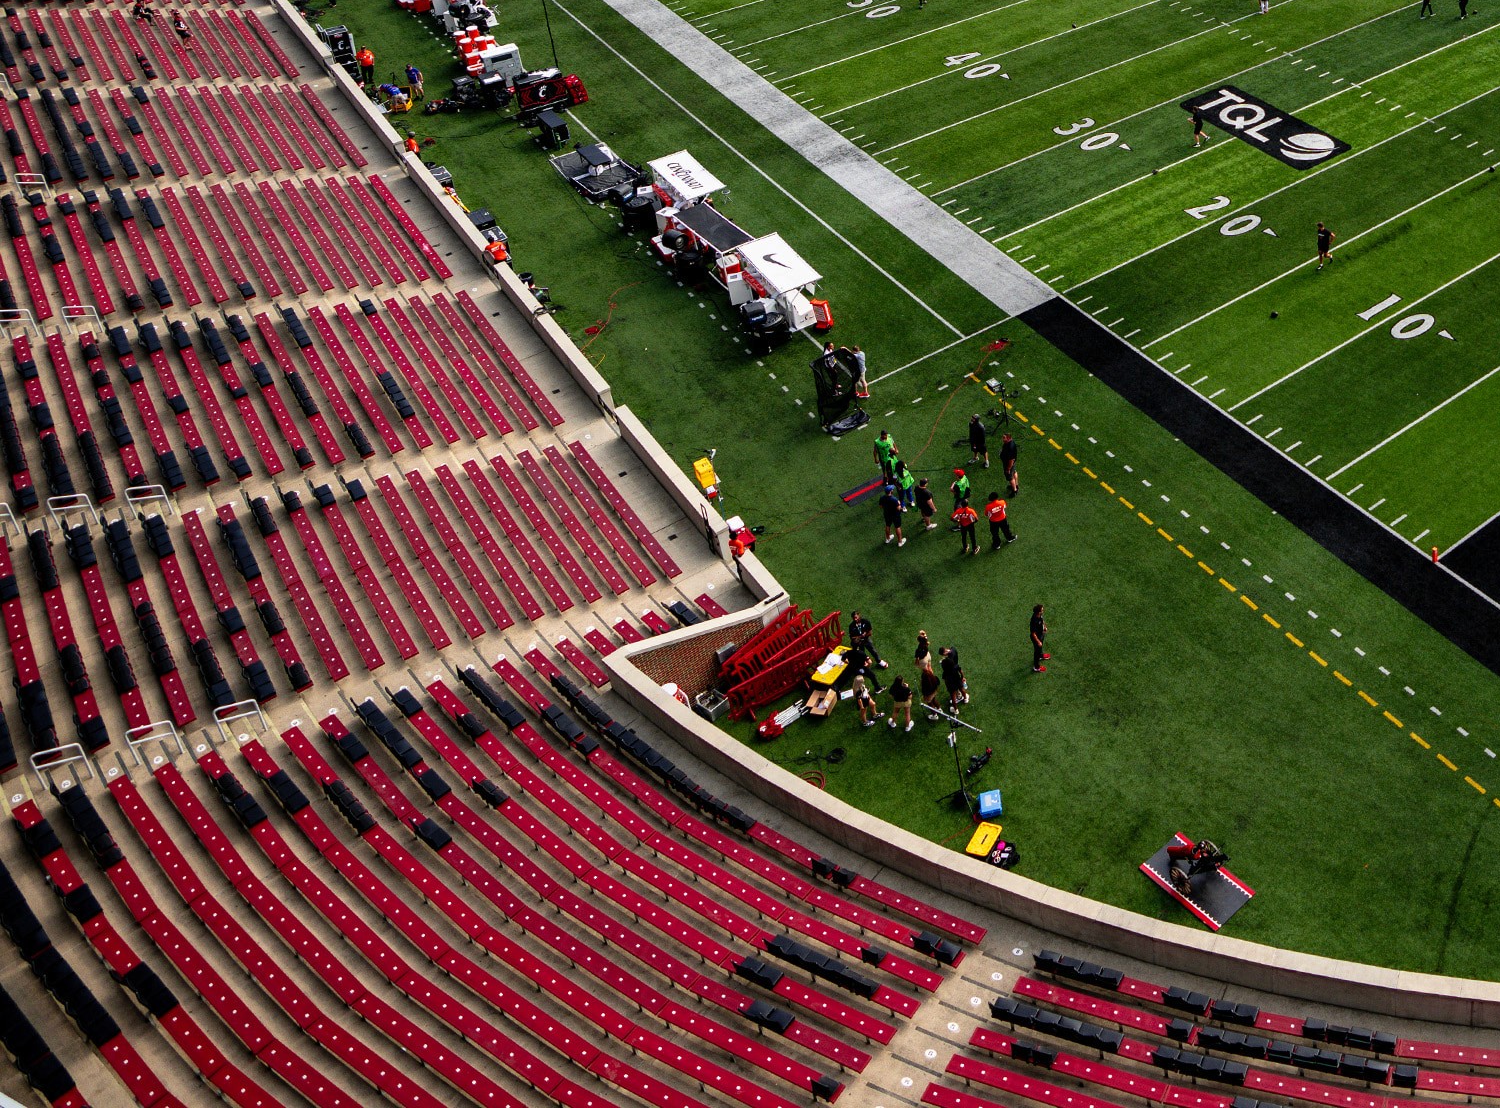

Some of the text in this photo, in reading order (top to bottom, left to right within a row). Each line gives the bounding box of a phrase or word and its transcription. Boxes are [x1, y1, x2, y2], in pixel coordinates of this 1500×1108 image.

[943, 51, 1003, 80] 40
[1052, 116, 1122, 152] 30
[1200, 88, 1288, 143] TQL
[1183, 194, 1264, 237] 20
[1356, 292, 1436, 341] 10
